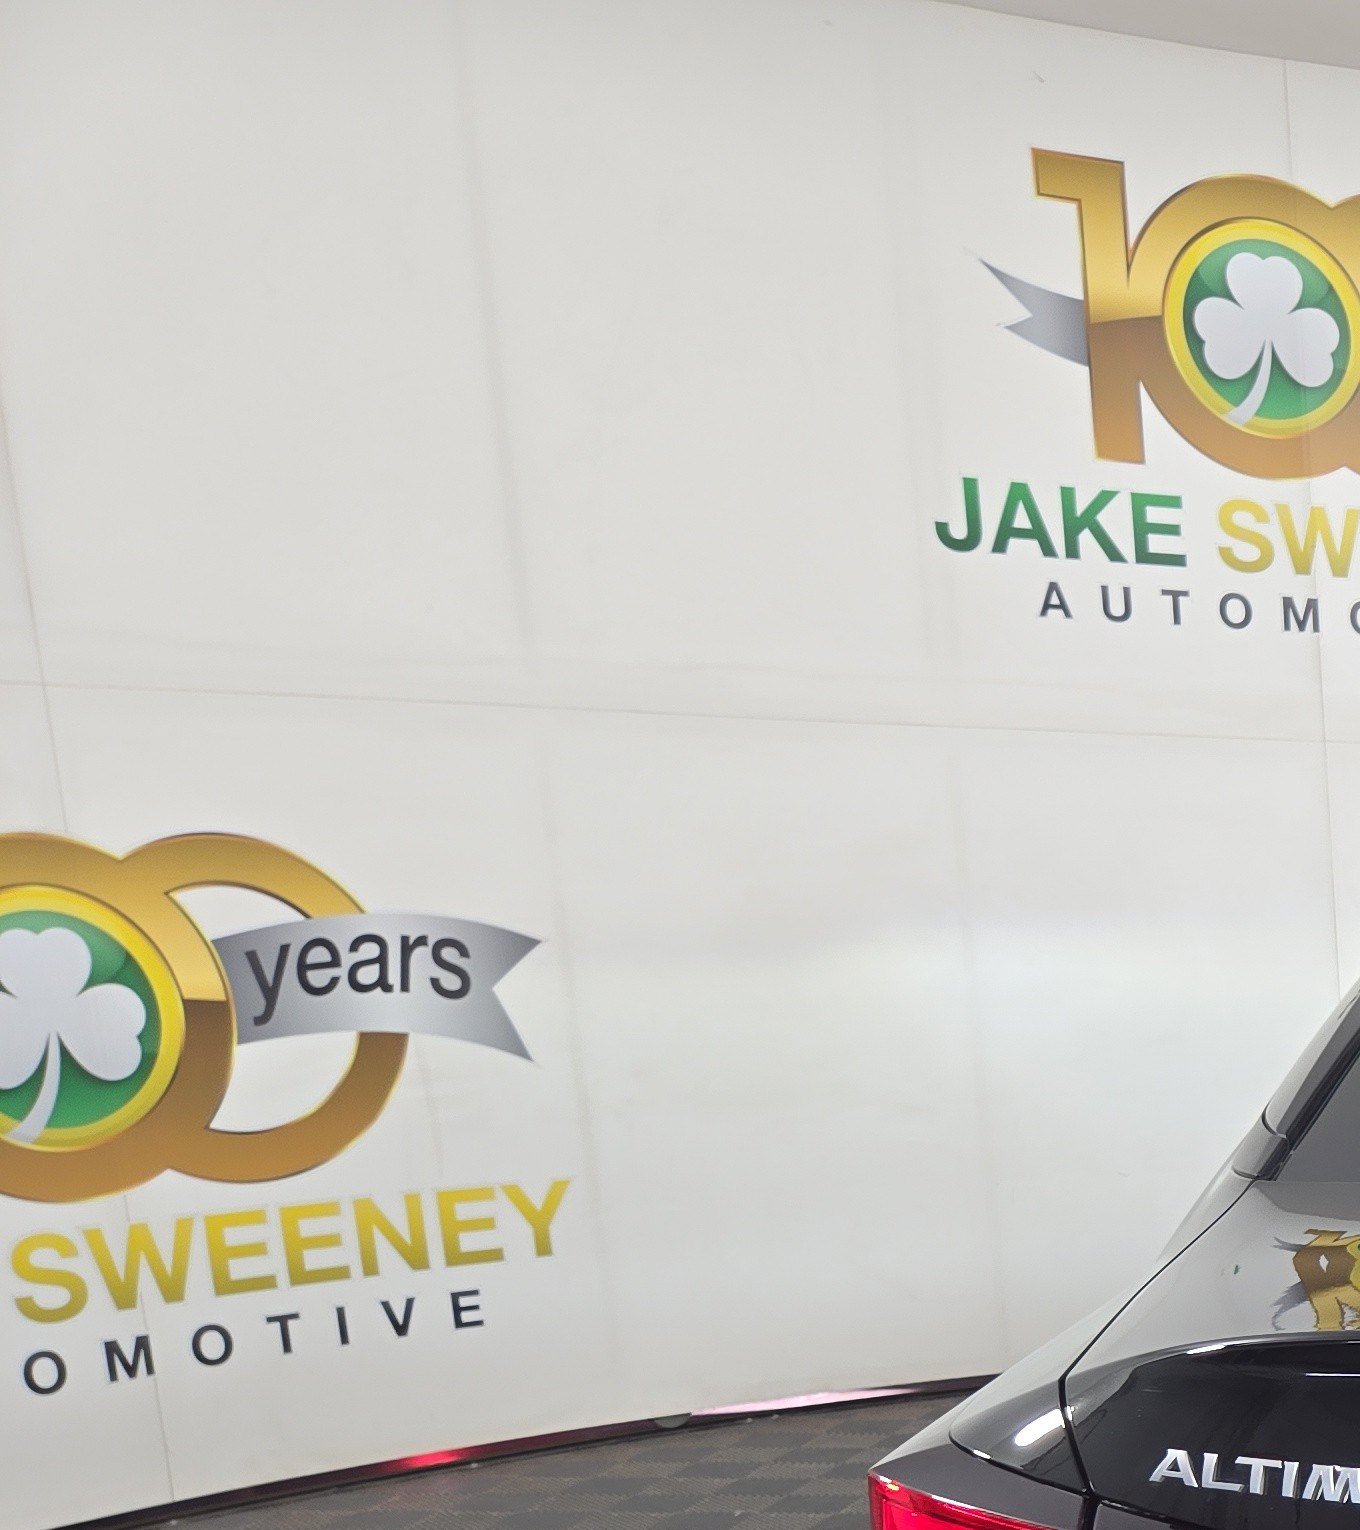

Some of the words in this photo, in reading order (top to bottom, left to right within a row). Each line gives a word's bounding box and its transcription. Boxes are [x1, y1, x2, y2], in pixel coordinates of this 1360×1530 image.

[935, 476, 1188, 568] JAKE
[244, 932, 472, 1026] years
[11, 1180, 571, 1324] SWEENEY
